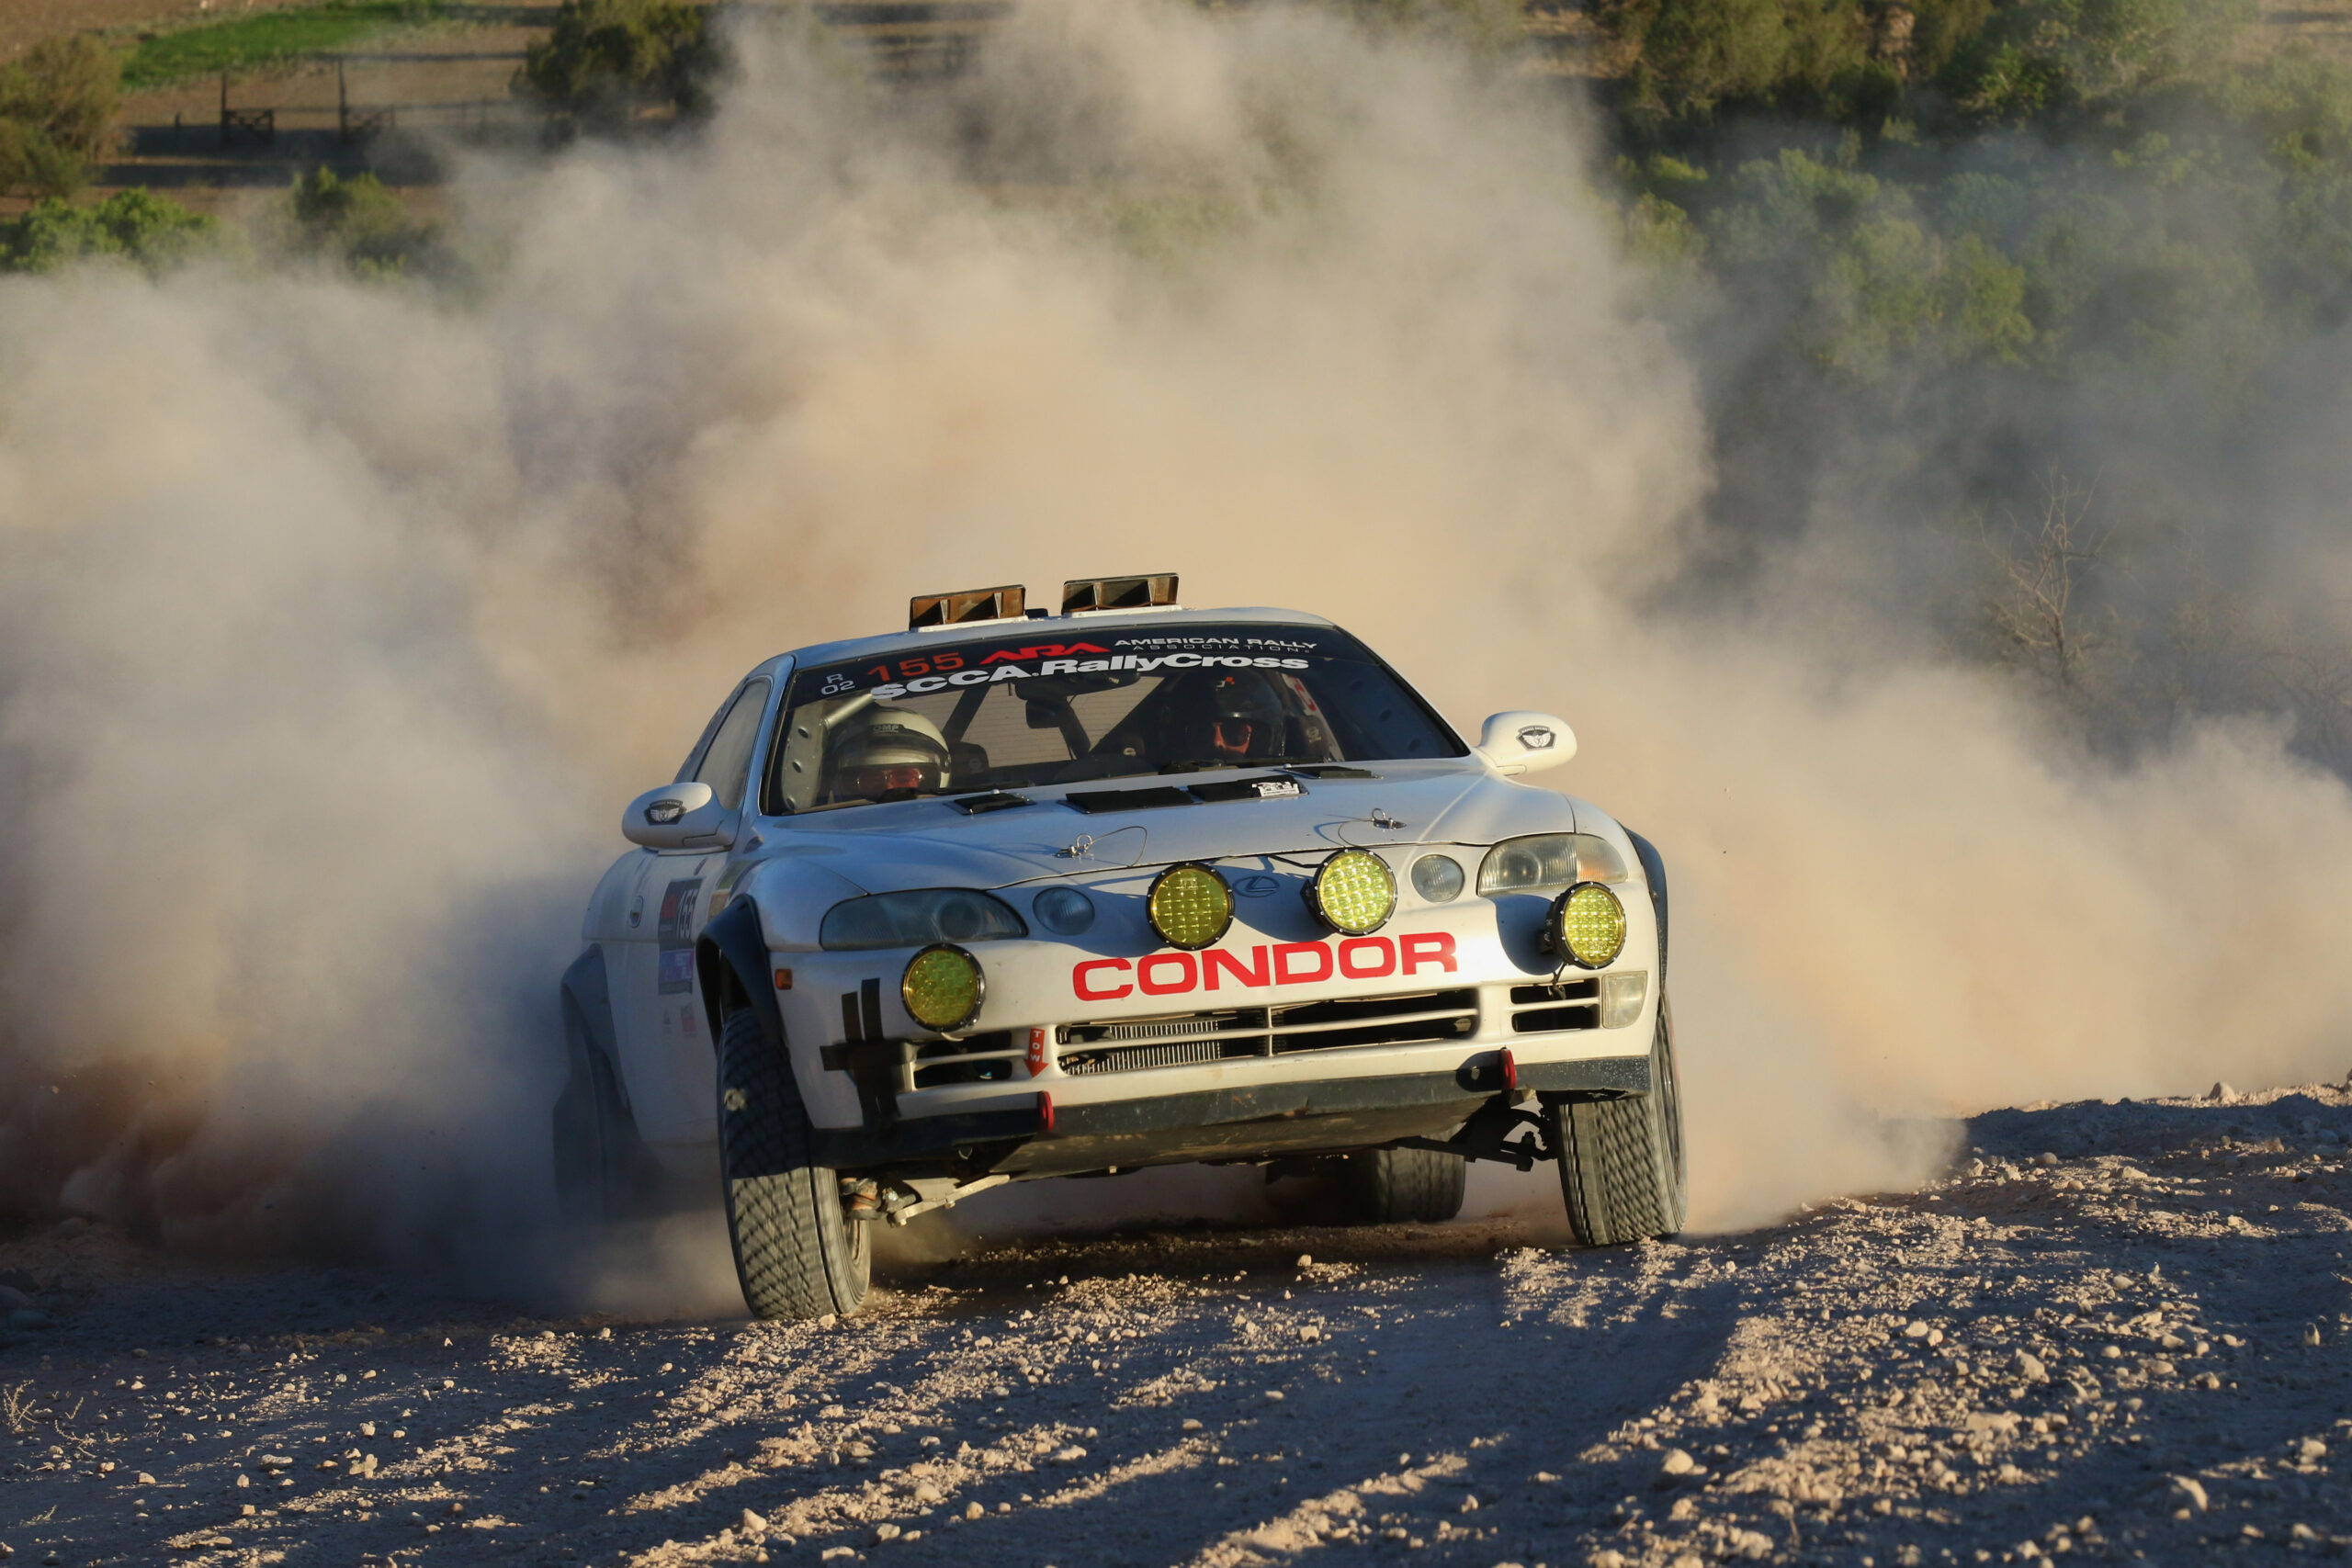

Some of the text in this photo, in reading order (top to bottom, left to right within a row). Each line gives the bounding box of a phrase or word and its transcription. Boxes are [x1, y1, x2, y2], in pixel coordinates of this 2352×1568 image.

[979, 642, 1112, 665] ARA
[1114, 637, 1317, 649] AMERICAN RALLY
[827, 673, 844, 684] R
[867, 652, 964, 682] 155
[1073, 931, 1458, 1001] CONDOR
[1030, 1030, 1042, 1063] TOW
